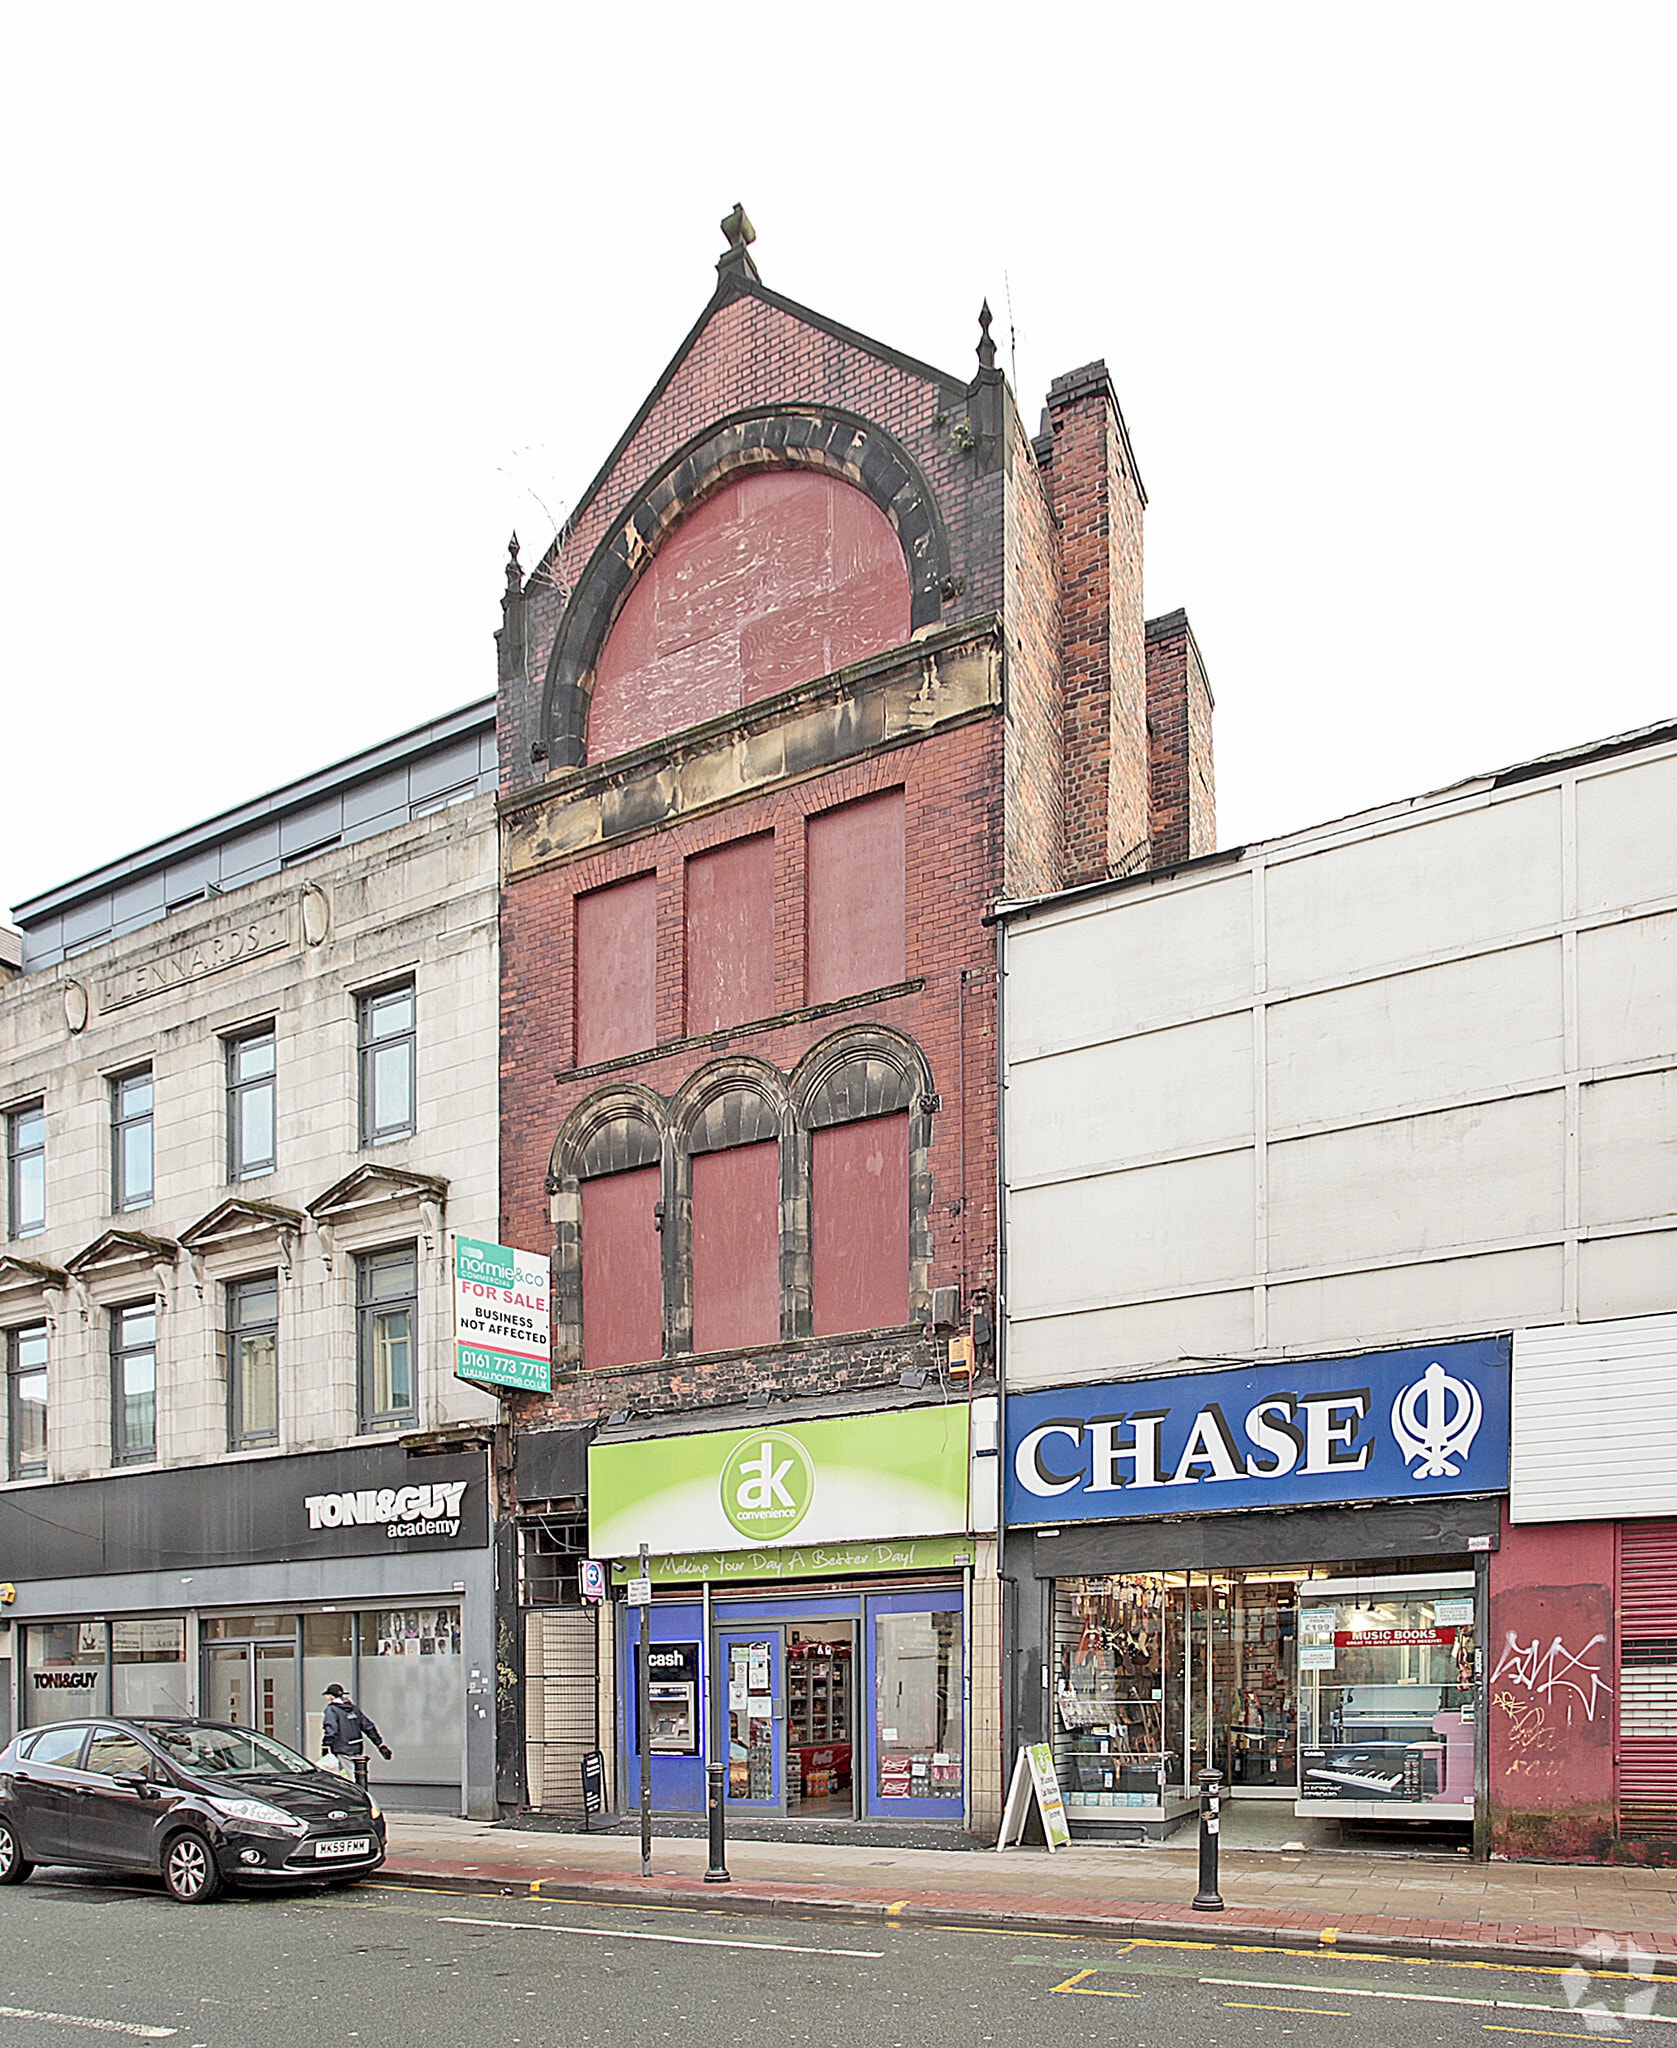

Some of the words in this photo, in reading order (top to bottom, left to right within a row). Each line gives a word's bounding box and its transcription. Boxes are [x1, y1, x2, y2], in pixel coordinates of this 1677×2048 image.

[461, 1270, 511, 1287] COMMERCIAL
[462, 1281, 498, 1301] FOR
[503, 1290, 545, 1312] SALE
[475, 1307, 534, 1329] BUSINESS
[460, 1317, 486, 1331] NOT
[488, 1324, 547, 1344] AFFECTED
[462, 1351, 491, 1369] 0161
[493, 1356, 517, 1374] 773
[519, 1362, 548, 1379] 7715
[462, 1367, 548, 1390] www.normie.co.uk
[1014, 1388, 1373, 1498] CHASE
[304, 1481, 468, 1529] TONI&GUY
[736, 1508, 797, 1521] convenience
[386, 1519, 461, 1538] academy
[659, 1556, 710, 1578] Making
[712, 1555, 745, 1575] Your
[747, 1552, 783, 1575] Day
[788, 1551, 806, 1571] A
[811, 1549, 869, 1569] Better
[871, 1544, 916, 1567] Day!
[1305, 1623, 1330, 1631] £199
[1352, 1631, 1392, 1640] MUSIC
[1393, 1629, 1437, 1639] BOOKS
[648, 1650, 684, 1666] cash
[33, 1672, 98, 1689] TONI&GUY
[320, 1841, 346, 1854] MK59
